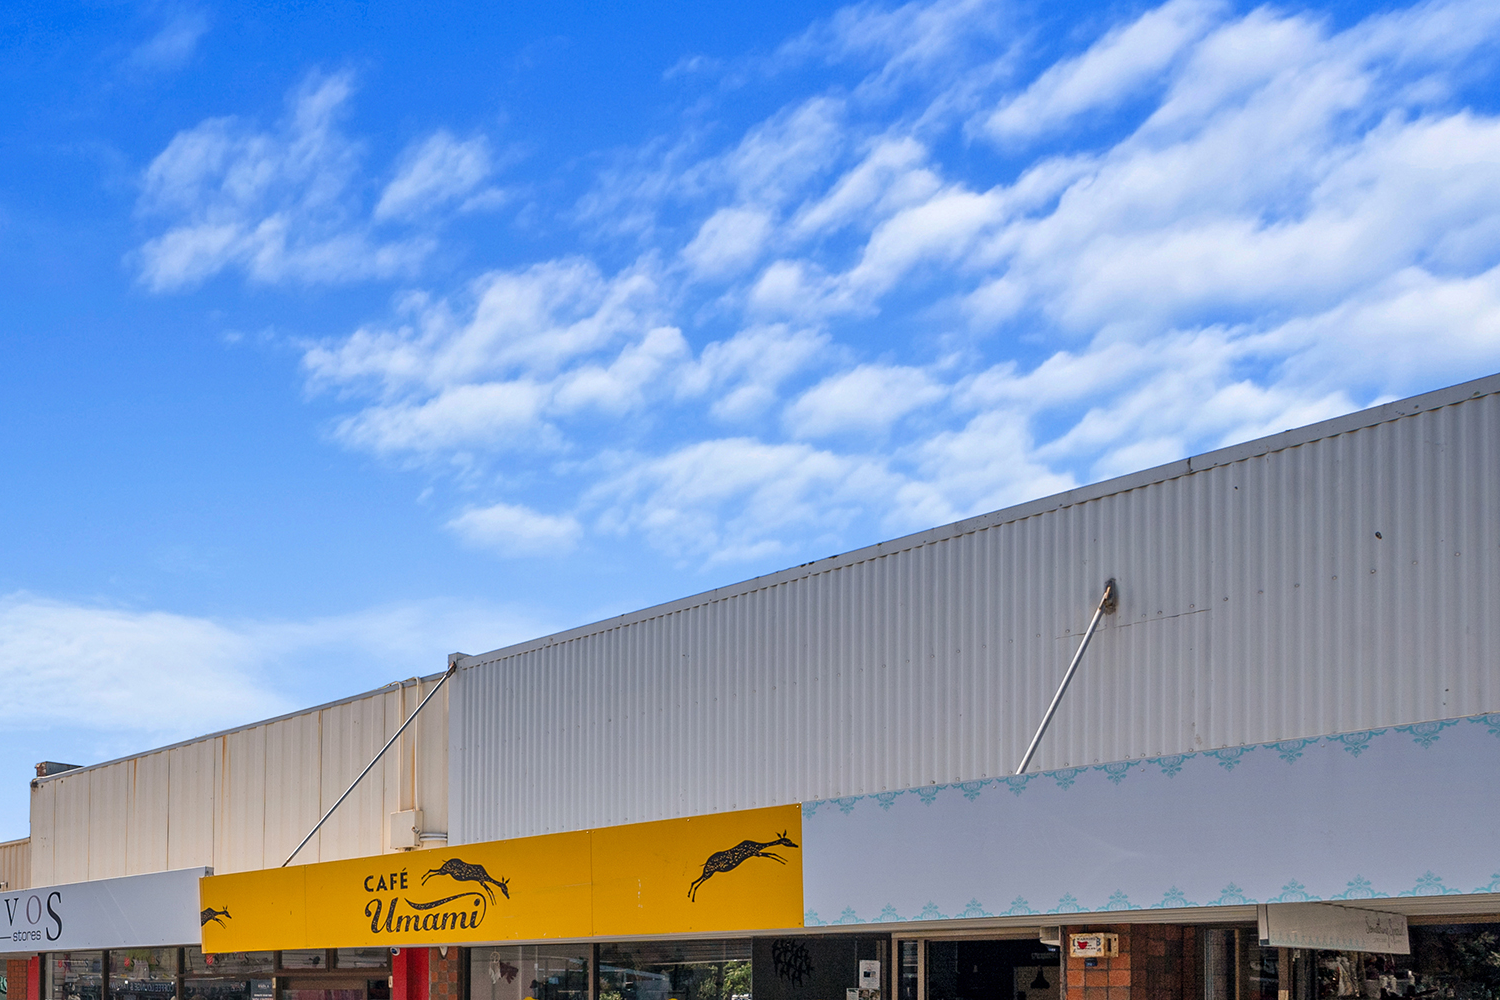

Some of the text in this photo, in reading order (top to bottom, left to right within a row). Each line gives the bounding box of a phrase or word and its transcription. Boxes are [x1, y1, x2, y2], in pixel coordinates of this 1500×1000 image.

[363, 867, 409, 892] CAFÉ
[364, 891, 487, 934] Umami
[12, 930, 42, 942] stores
